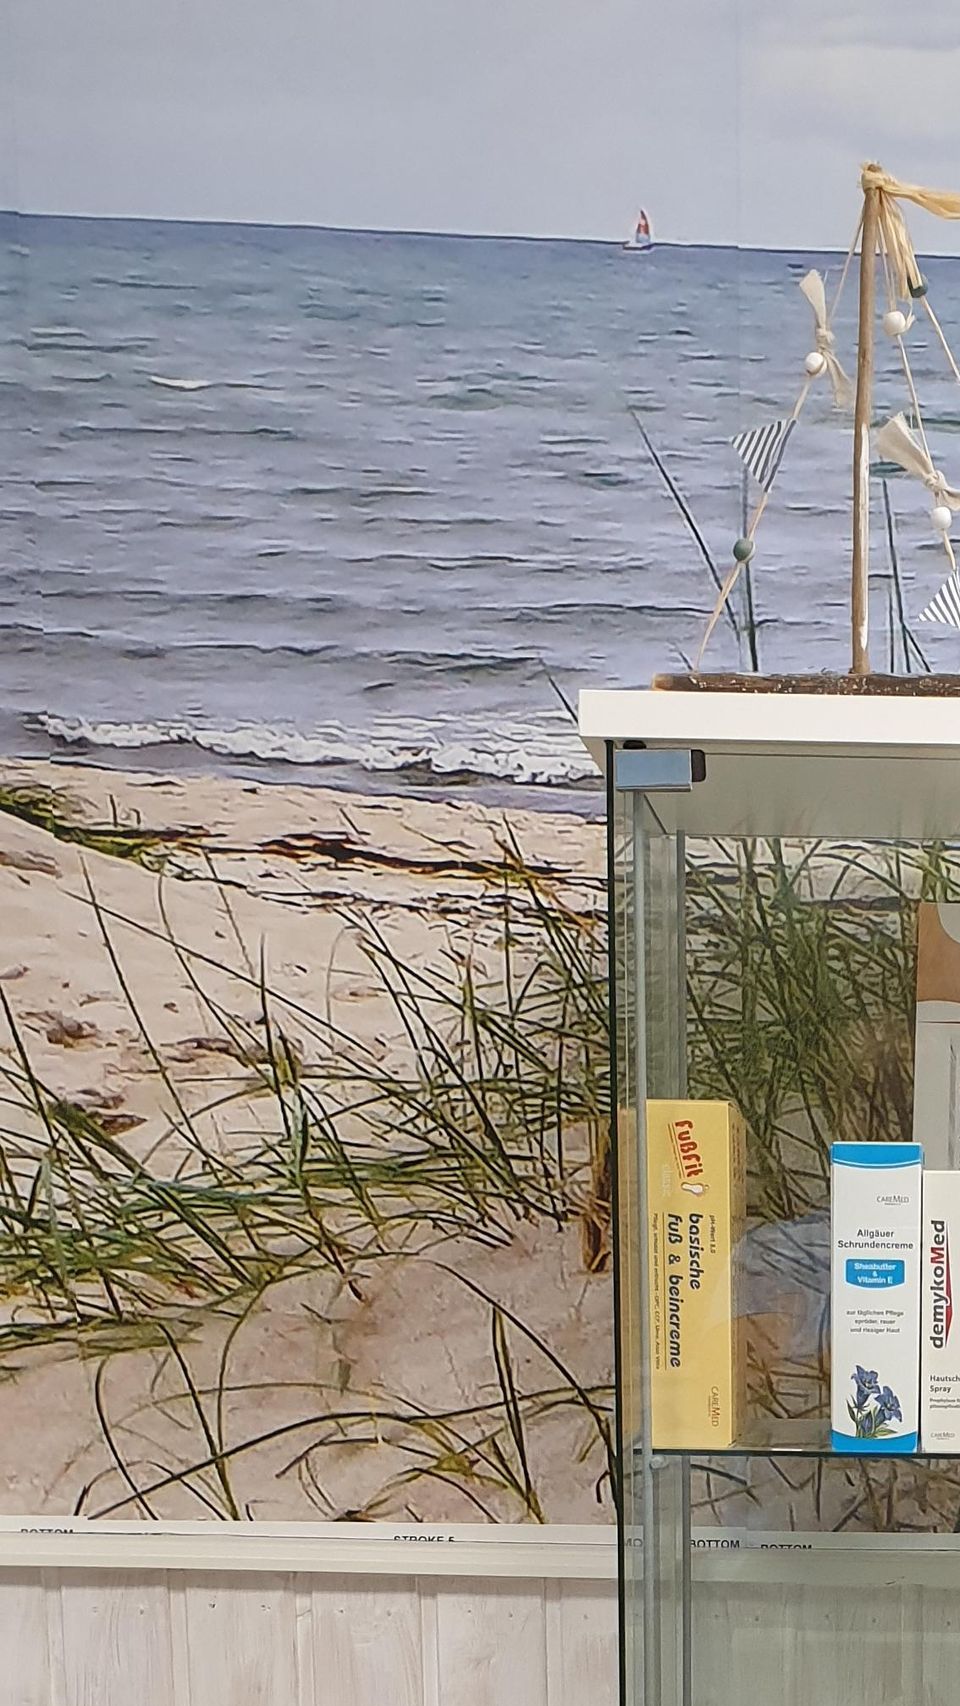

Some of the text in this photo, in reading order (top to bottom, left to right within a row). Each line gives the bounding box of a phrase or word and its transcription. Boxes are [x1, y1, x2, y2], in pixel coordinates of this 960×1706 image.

[857, 1228, 894, 1239] Allgäuer
[837, 1240, 914, 1250] Schrundencreme
[688, 1213, 705, 1290] basische
[857, 1276, 886, 1284] Vitamin
[929, 1220, 950, 1349] demykoMed
[668, 1213, 685, 1368] fuß & beincreme
[929, 1384, 951, 1393] Spray
